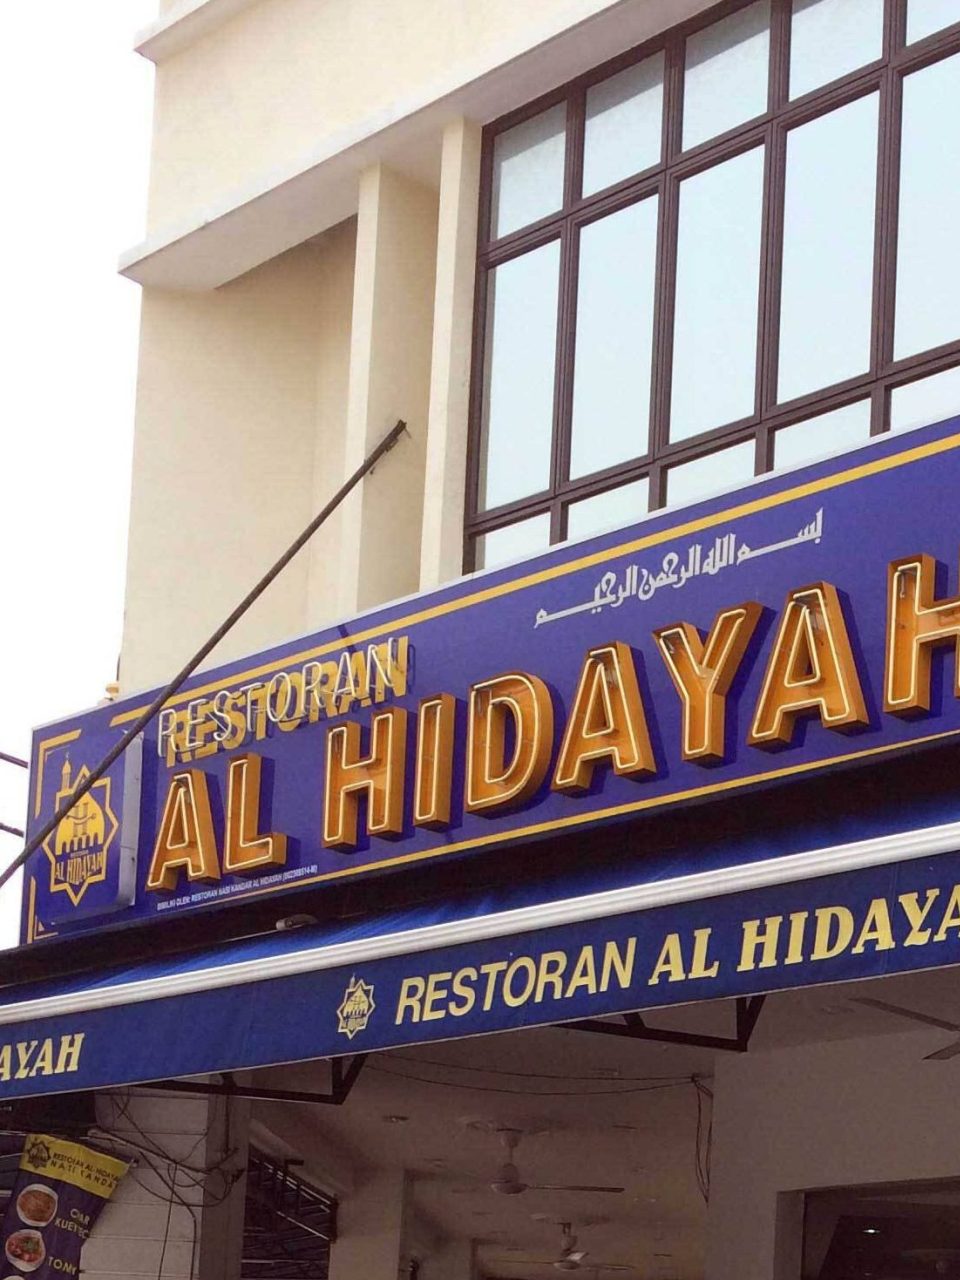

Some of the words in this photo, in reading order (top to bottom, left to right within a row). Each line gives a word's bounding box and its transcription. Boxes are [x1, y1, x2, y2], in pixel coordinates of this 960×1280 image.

[158, 636, 409, 768] RESTORAN
[145, 752, 287, 892] AL
[395, 937, 636, 1025] RESTORAN
[648, 926, 720, 986] AL
